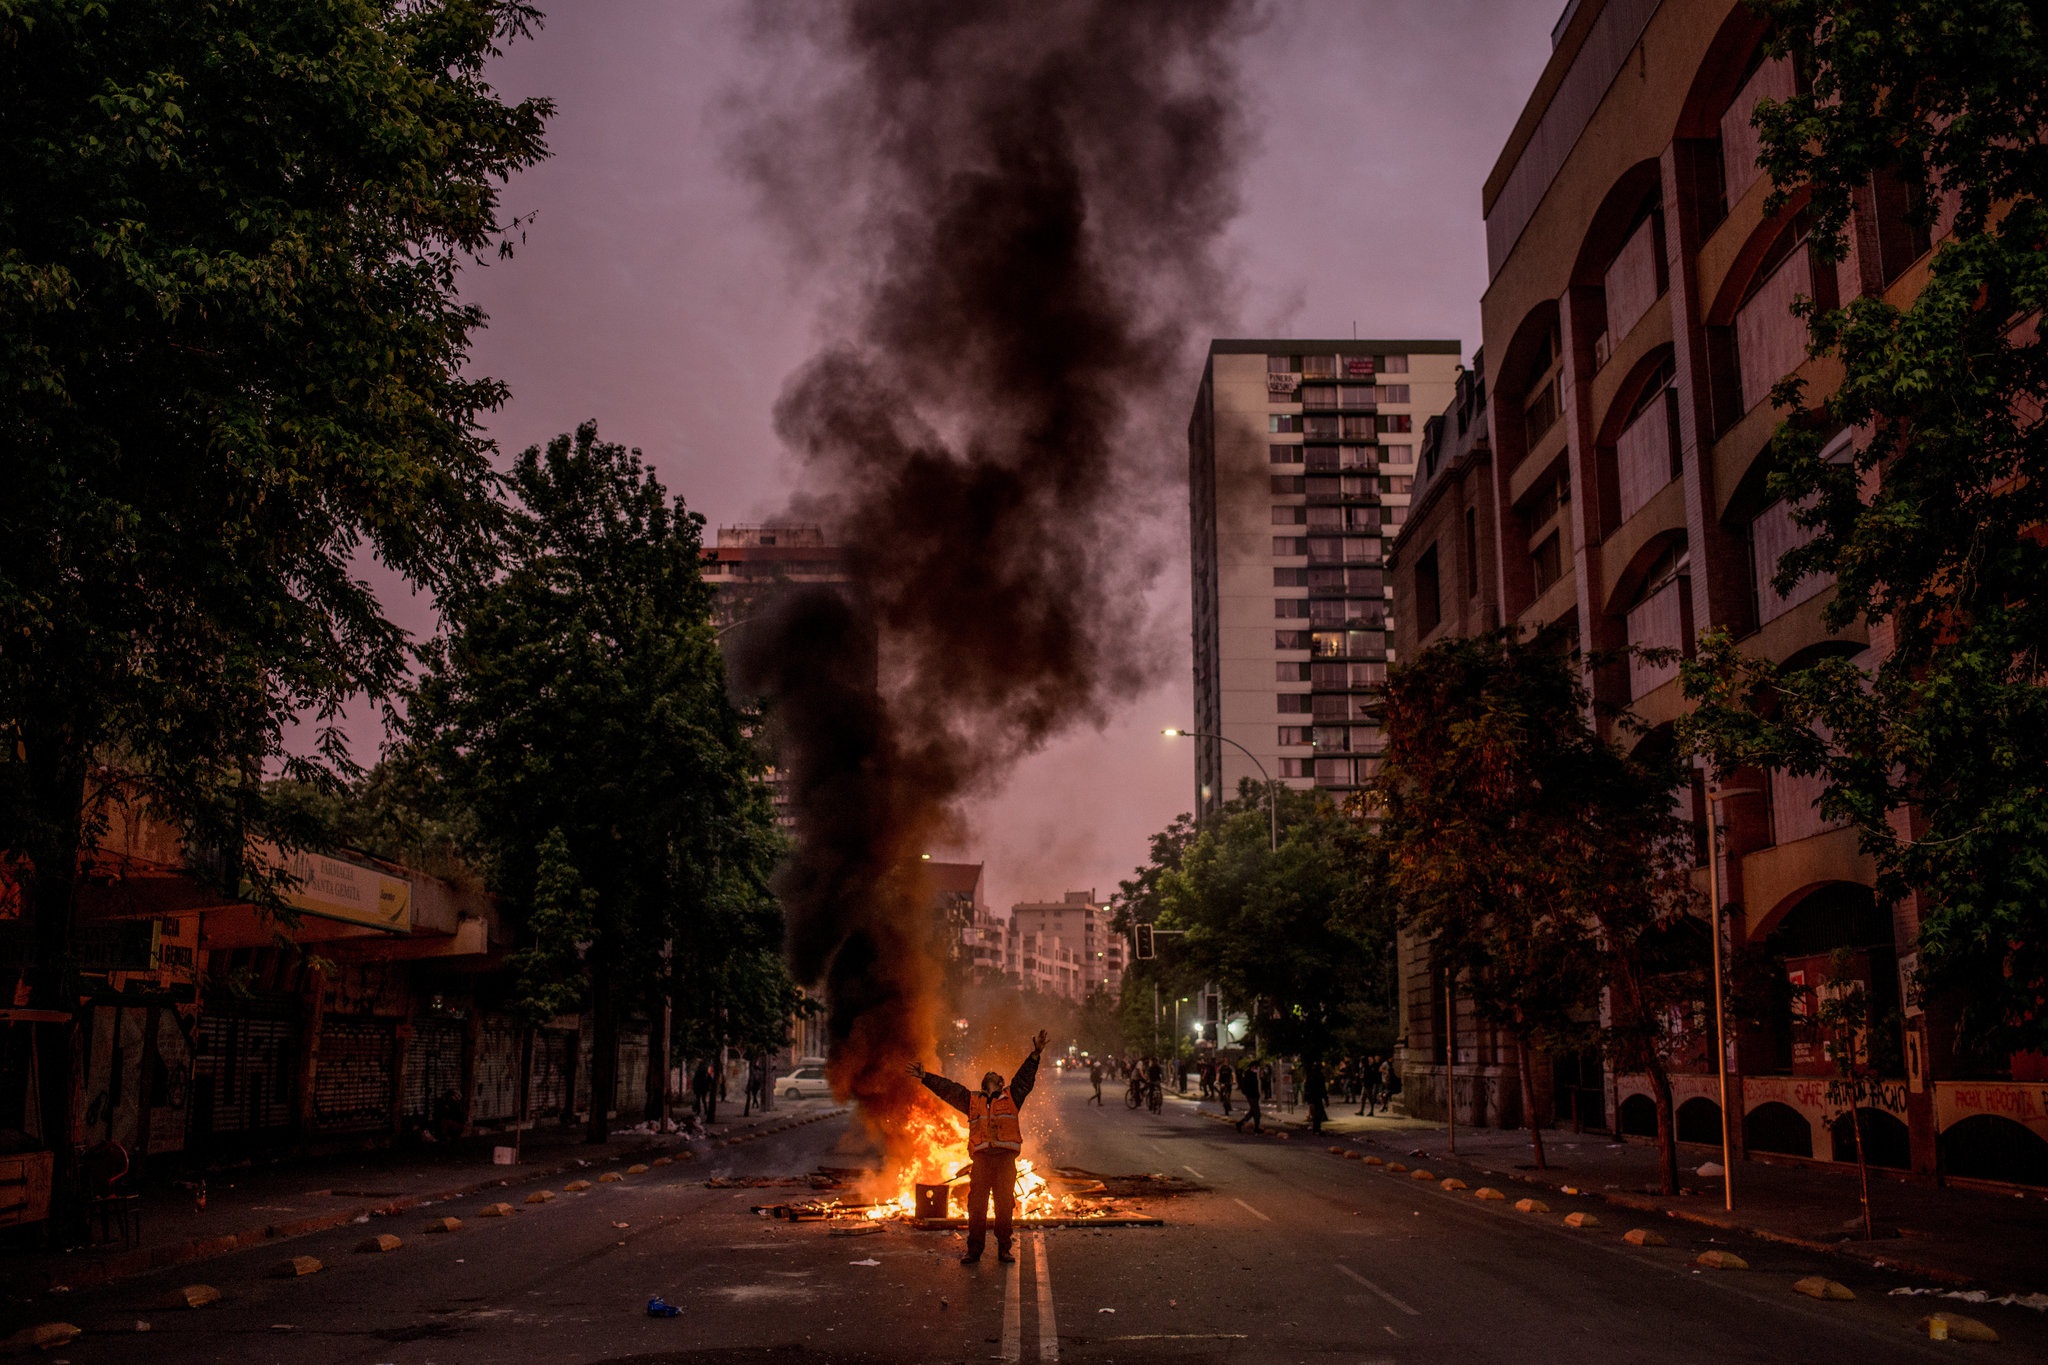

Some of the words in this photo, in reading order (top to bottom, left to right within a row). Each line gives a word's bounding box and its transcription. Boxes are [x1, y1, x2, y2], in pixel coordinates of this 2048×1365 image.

[320, 860, 354, 881] FARMACIA
[312, 879, 334, 896] SANTA
[335, 883, 361, 902] GEMITA
